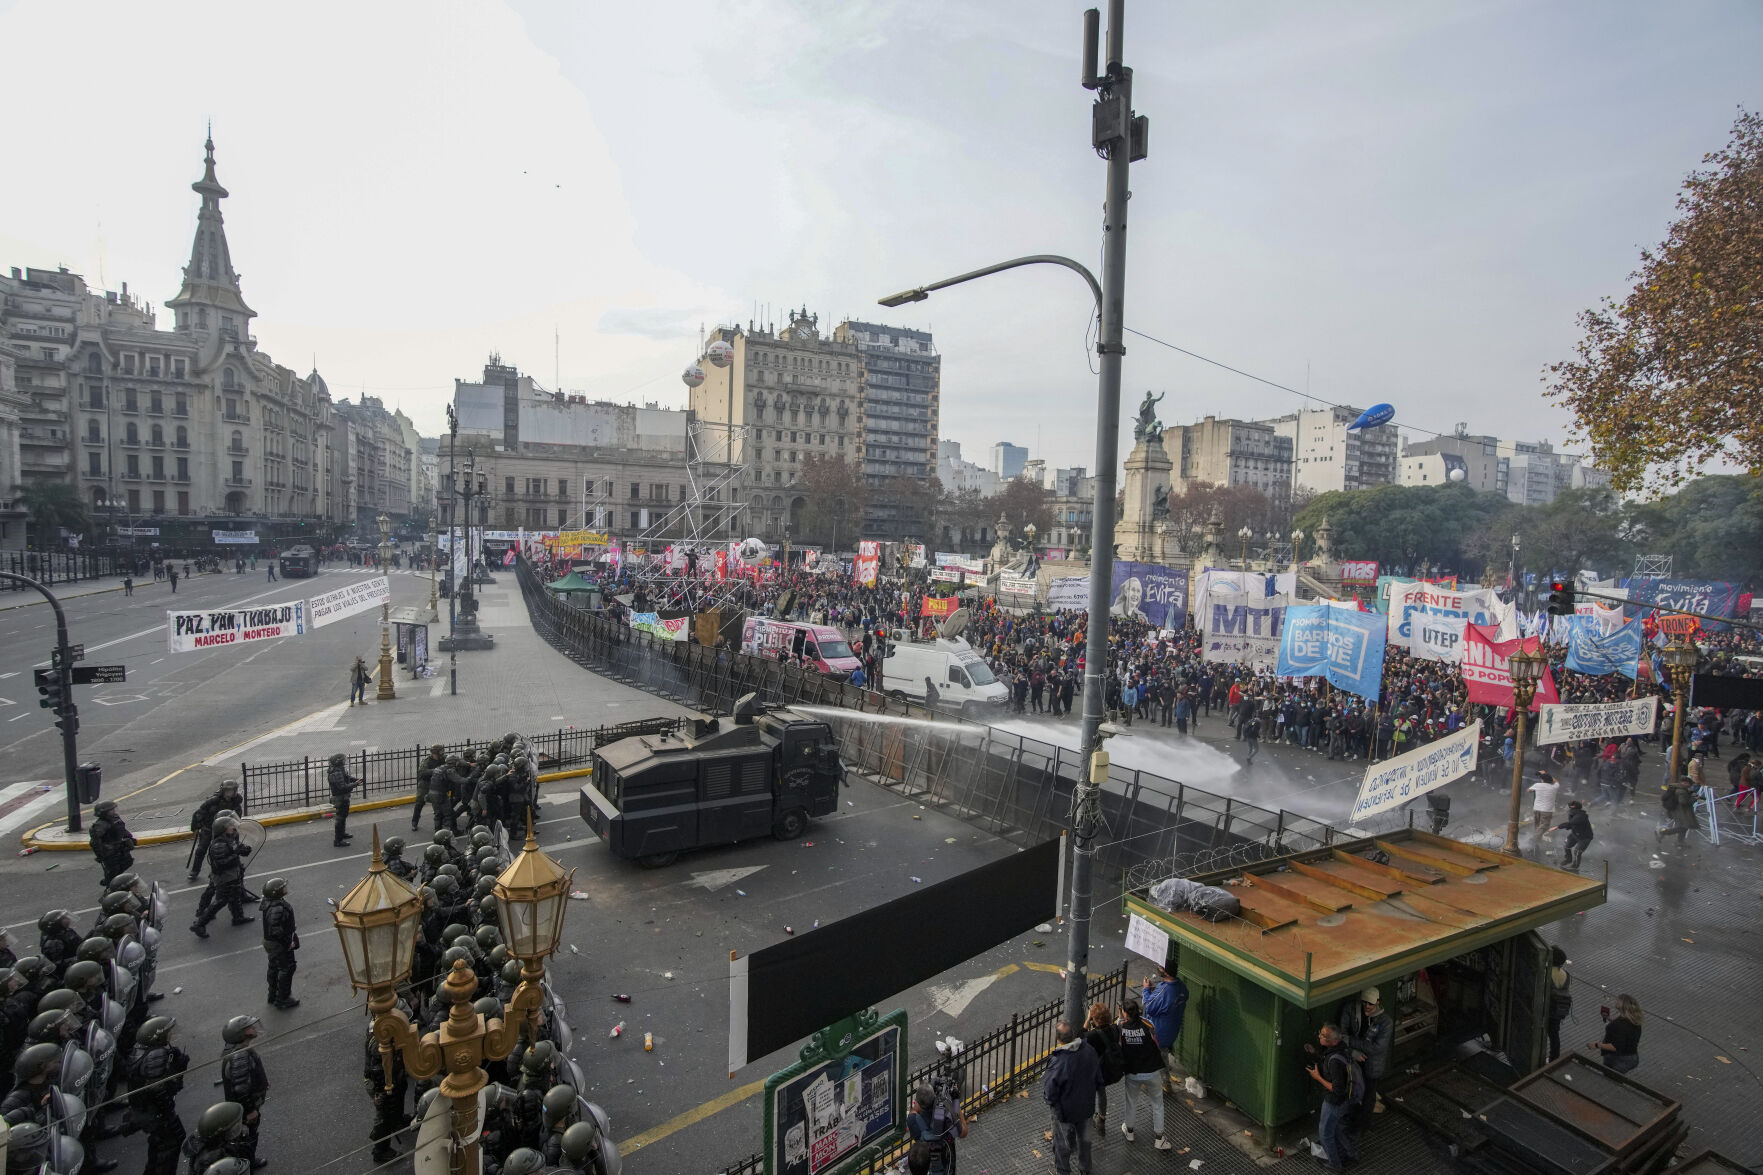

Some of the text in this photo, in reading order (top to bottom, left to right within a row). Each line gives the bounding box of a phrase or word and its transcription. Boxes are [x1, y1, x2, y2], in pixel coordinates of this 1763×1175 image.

[371, 579, 386, 588] GENTE
[333, 602, 342, 612] LOS
[360, 594, 368, 603] DEL
[1144, 584, 1185, 608] Evita
[1404, 591, 1462, 609] FRENTE
[208, 613, 236, 631] PAN
[241, 606, 291, 628] TRABAJO
[194, 626, 281, 648] MARCELO MONTERO
[1423, 627, 1459, 649] UTEP
[1294, 642, 1321, 657] DE
[1122, 1028, 1146, 1037] PRENSA
